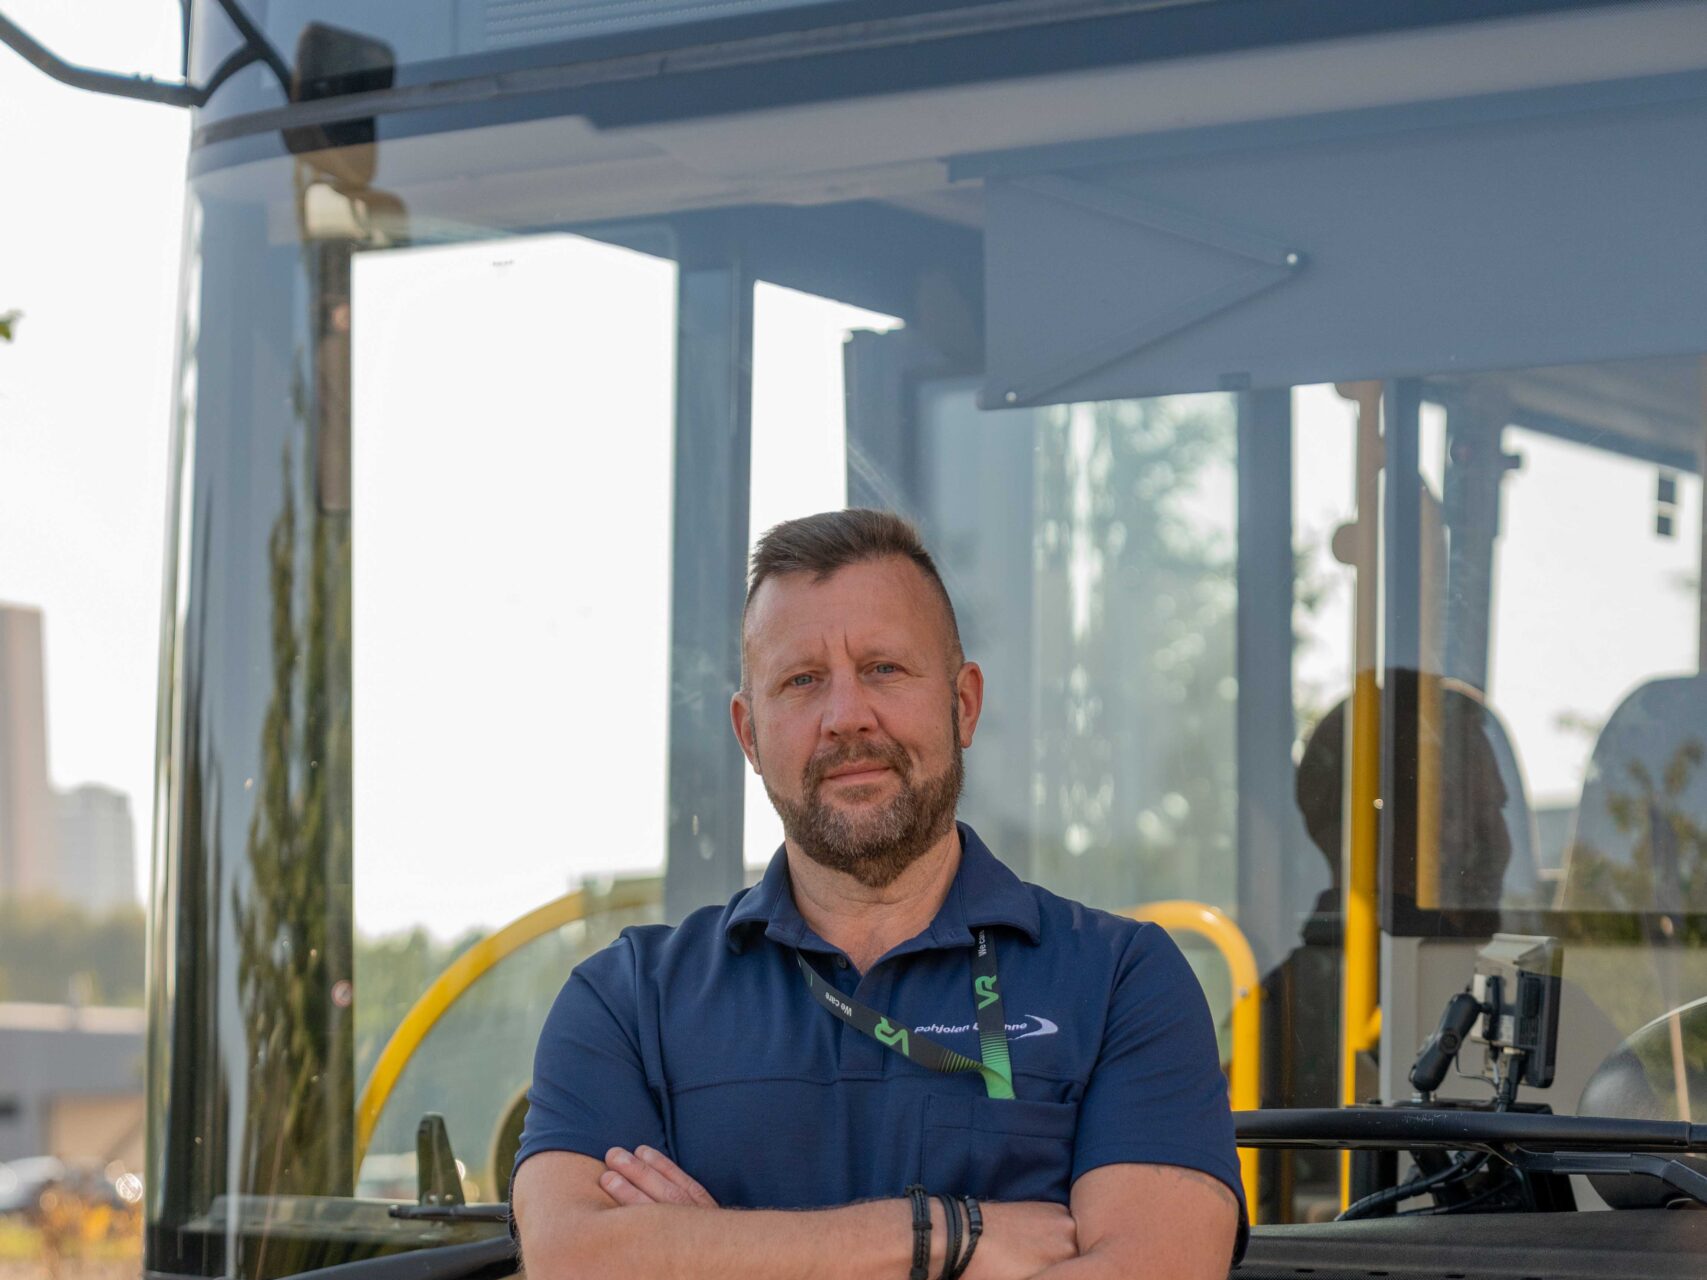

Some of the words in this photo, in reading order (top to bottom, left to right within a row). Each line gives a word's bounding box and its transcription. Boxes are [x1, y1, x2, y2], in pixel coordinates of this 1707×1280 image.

[825, 992, 840, 1007] care
[840, 1003, 852, 1016] We
[914, 1023, 969, 1034] pohjolan
